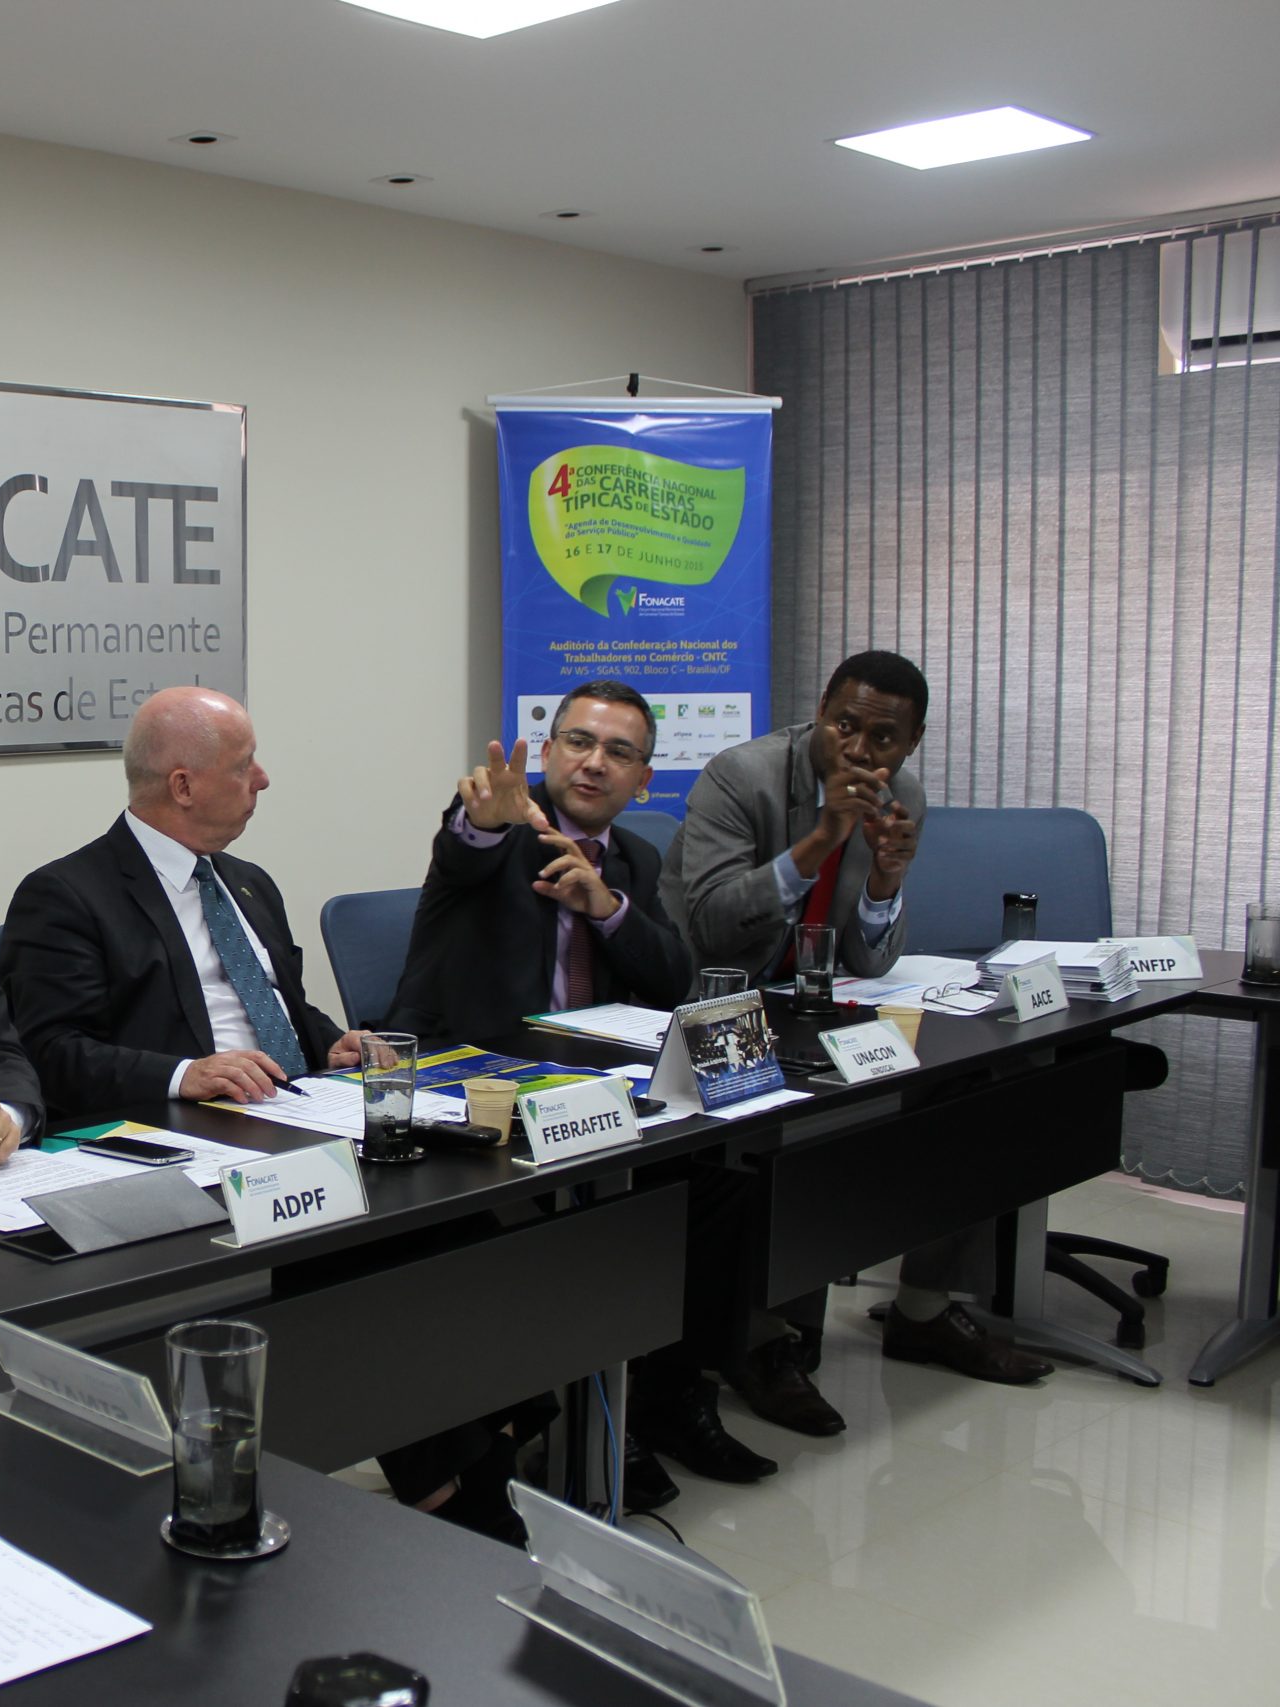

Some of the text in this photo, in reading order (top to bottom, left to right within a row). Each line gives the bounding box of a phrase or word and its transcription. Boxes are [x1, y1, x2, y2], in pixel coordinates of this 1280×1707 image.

[576, 464, 660, 485] CONFERÊNCIA
[663, 478, 717, 499] NACIONAL
[576, 476, 696, 512] DAS CARREIRAS
[562, 491, 714, 530] TÍPICAS DE ESTADO
[566, 546, 580, 559] 16
[586, 544, 592, 554] E
[598, 544, 612, 554] 17
[617, 545, 633, 558] DE
[638, 552, 681, 568] JUNHO
[638, 593, 685, 606] FONACATE
[4, 610, 221, 655] Permanente
[549, 640, 738, 652] Auditório da Confederação Nacional dos
[564, 653, 632, 663] Trabalhadores
[634, 655, 647, 663] no
[649, 652, 694, 662] Comércio
[702, 652, 727, 662] CNTC
[560, 666, 573, 675] AV
[644, 665, 669, 674] Bloco
[671, 665, 678, 674] C
[53, 677, 96, 722] de
[1130, 958, 1176, 974] ANFIP
[1031, 988, 1054, 1009] AACE
[852, 1045, 897, 1066] UNACON
[538, 1102, 567, 1114] FONACATE
[542, 1111, 623, 1144] FEBRAFITE
[246, 1173, 279, 1188] FONACATE
[272, 1187, 326, 1222] ADPF
